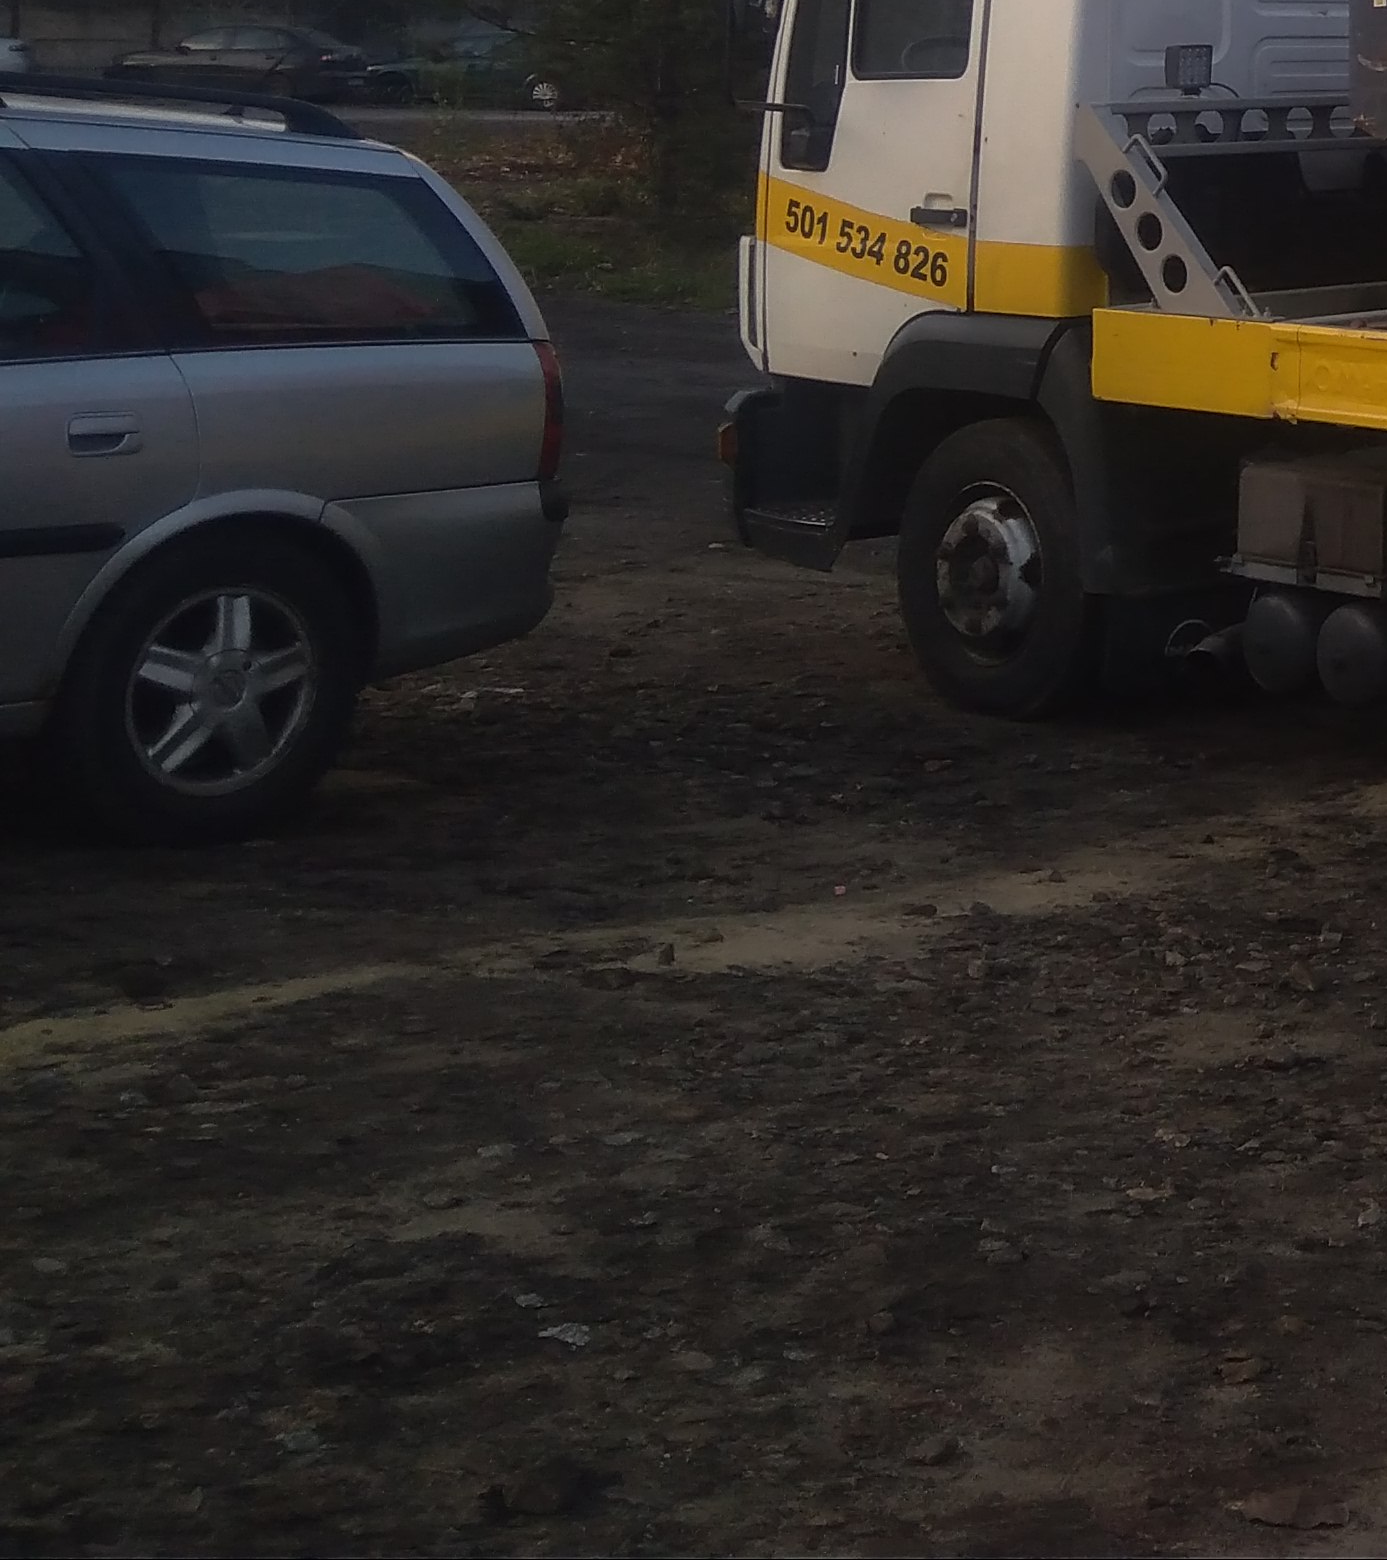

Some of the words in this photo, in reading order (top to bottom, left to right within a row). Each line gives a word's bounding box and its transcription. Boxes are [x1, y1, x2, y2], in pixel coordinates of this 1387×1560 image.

[785, 198, 829, 245] 501
[836, 218, 887, 266] 534
[893, 240, 949, 287] 826
